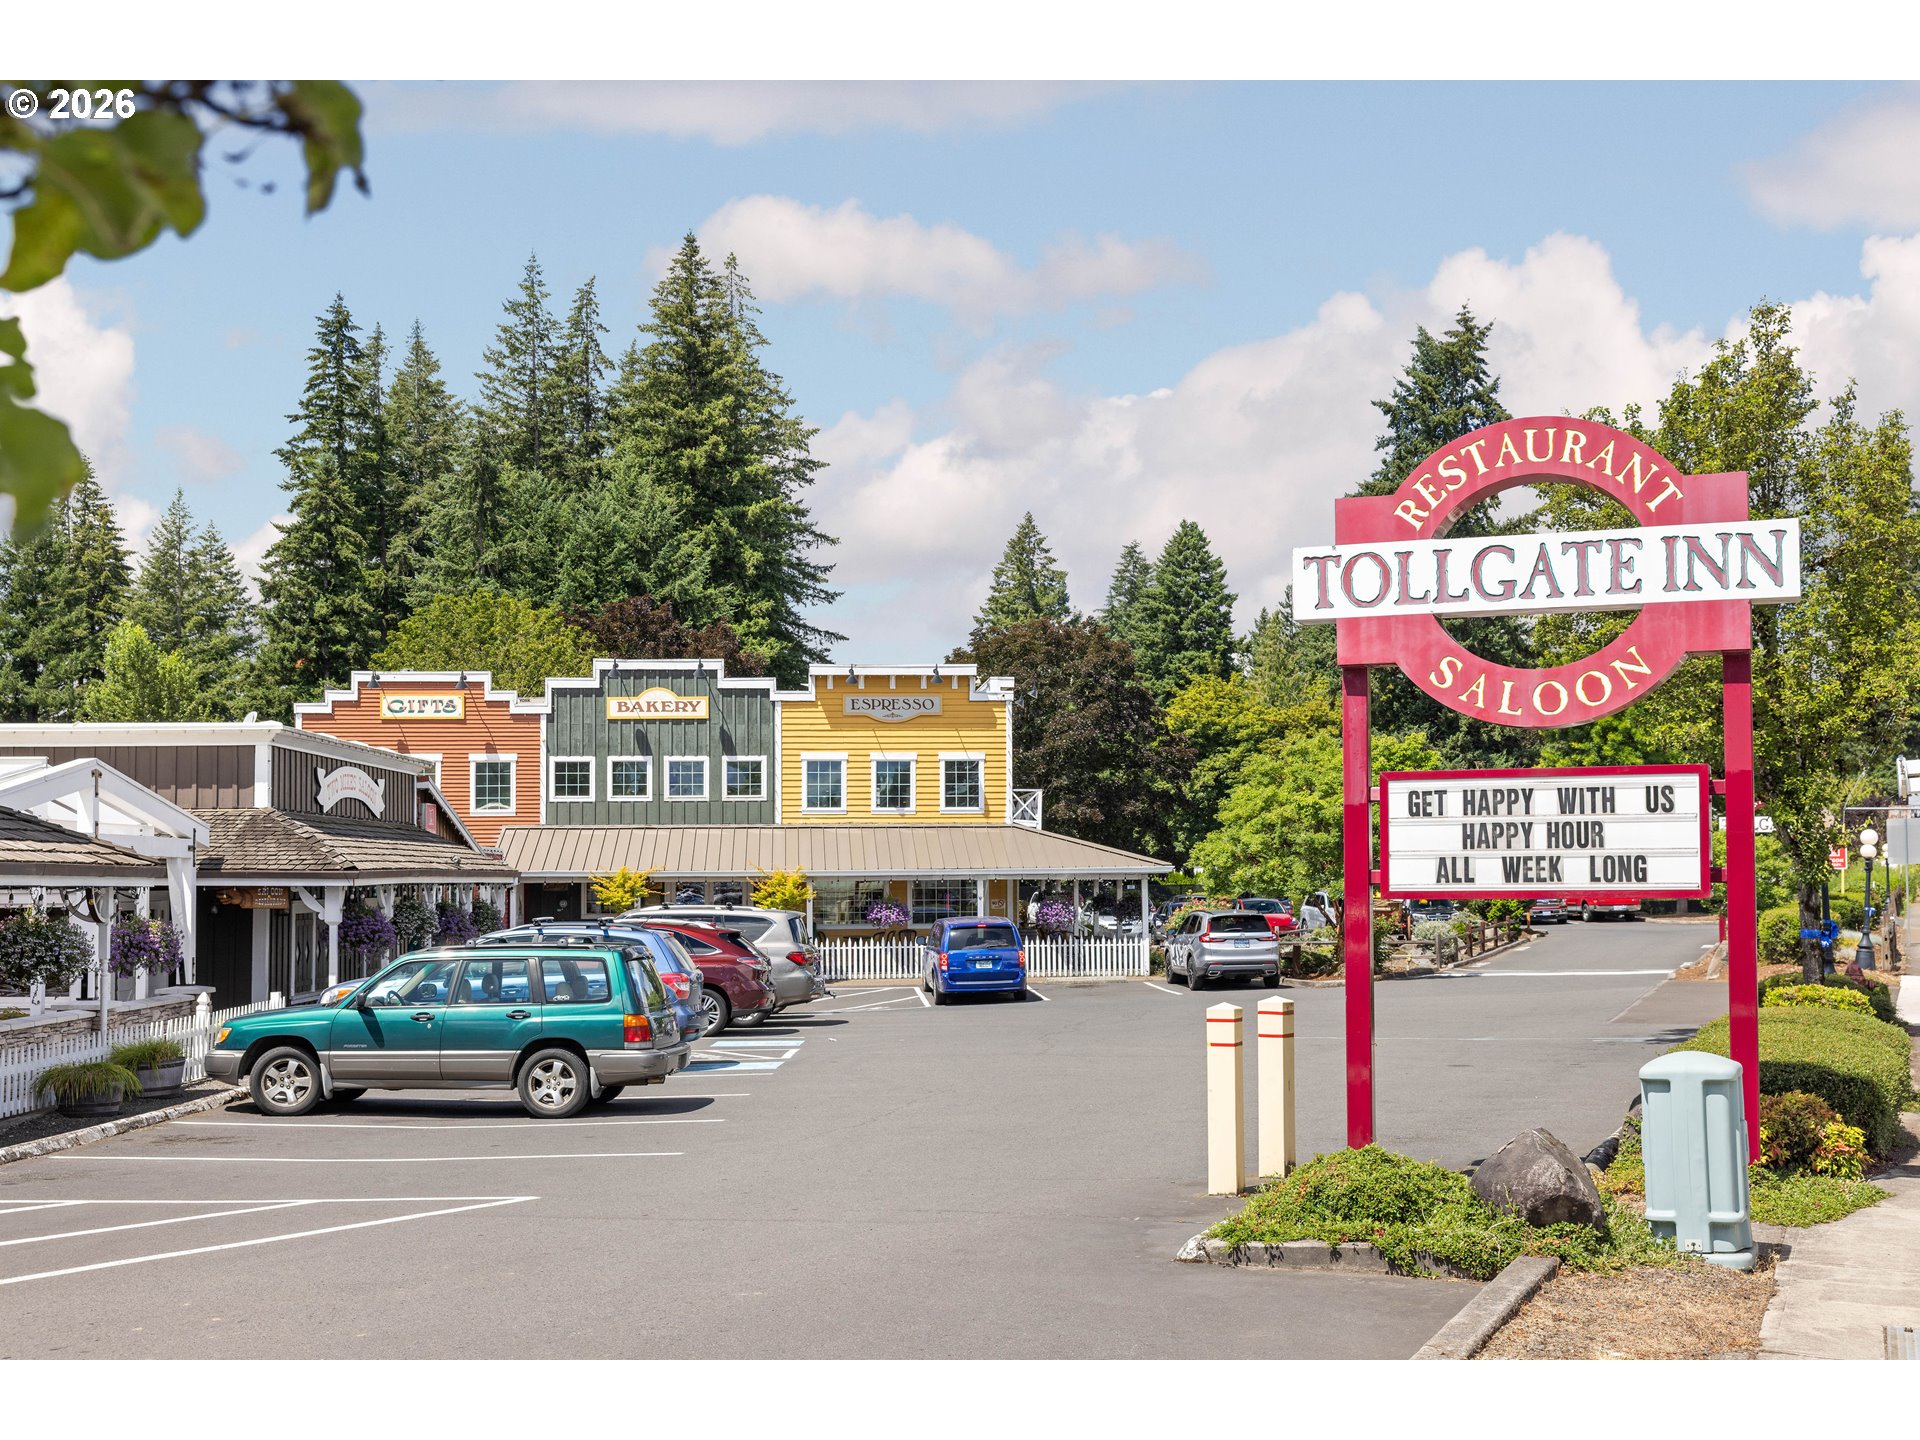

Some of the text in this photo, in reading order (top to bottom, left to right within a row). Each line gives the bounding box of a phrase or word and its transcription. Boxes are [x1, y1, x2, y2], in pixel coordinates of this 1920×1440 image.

[1393, 428, 1684, 532] RESTAURANT
[1303, 529, 1787, 610] TOLLGATE INN
[1429, 645, 1652, 717] SALOON
[387, 699, 457, 714] GIFTS
[616, 701, 702, 713] BAKERY
[850, 698, 935, 711] ESPRESSO
[1408, 785, 1675, 817] GET HAPPY WITH US
[1462, 821, 1604, 849] HAPPY HOUR
[1436, 854, 1647, 883] ALL WEEK LONG
